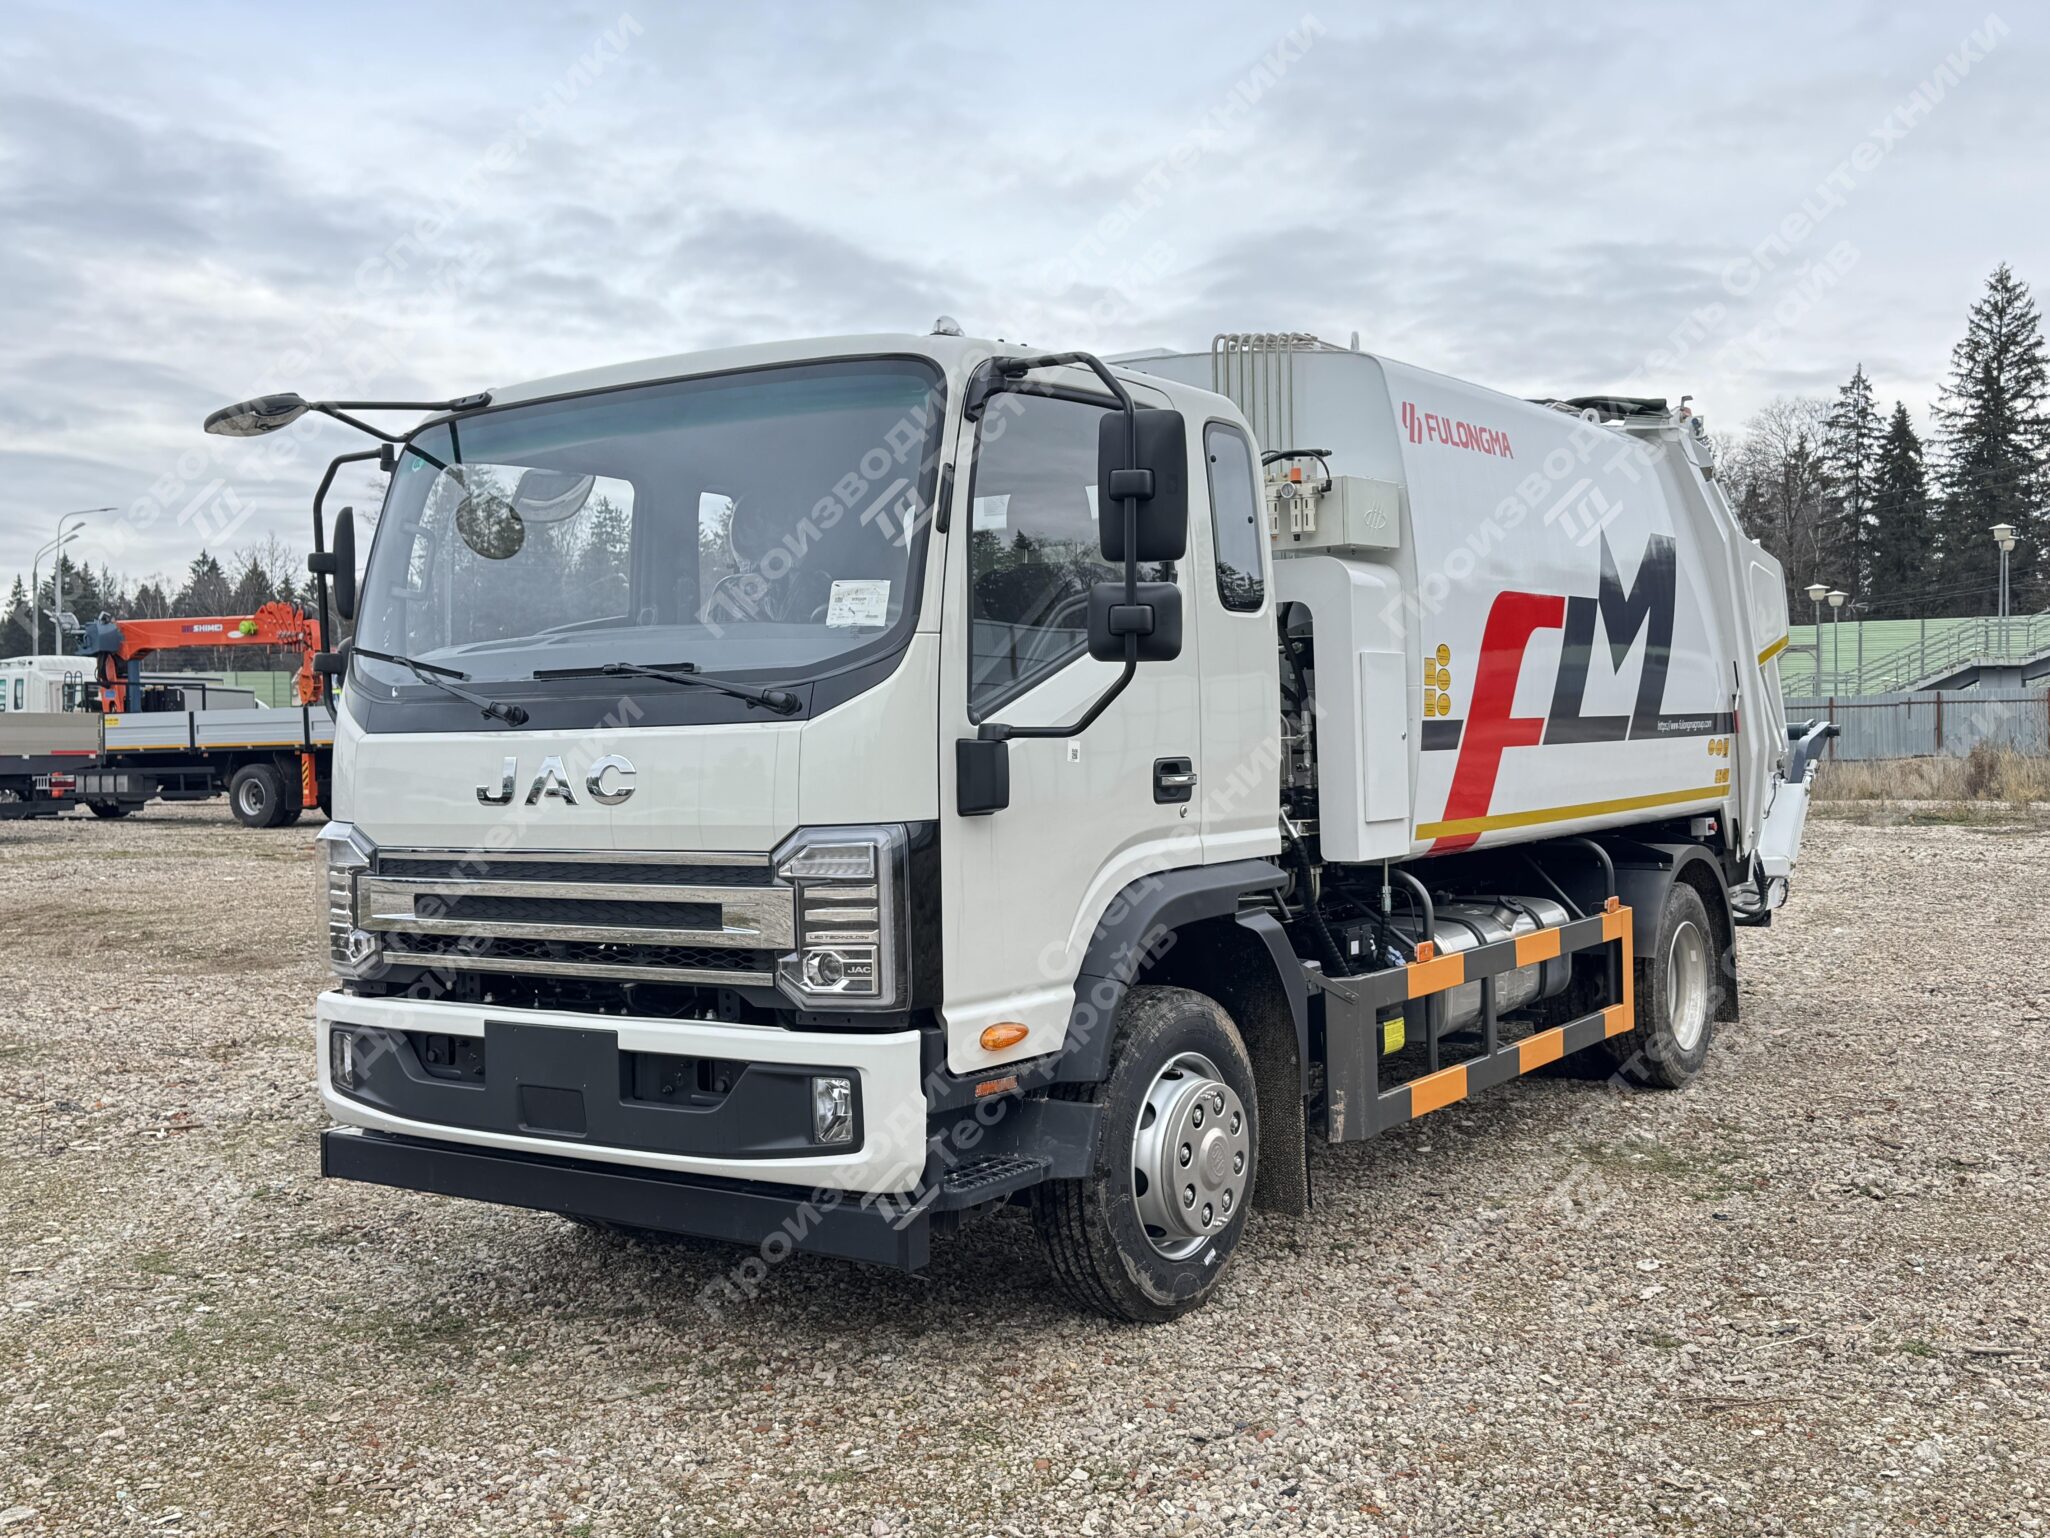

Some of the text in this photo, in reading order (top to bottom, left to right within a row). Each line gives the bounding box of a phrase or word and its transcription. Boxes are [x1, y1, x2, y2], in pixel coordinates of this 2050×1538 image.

[1425, 413, 1514, 459] FULONGMA
[476, 753, 637, 807] JAC
[847, 966, 872, 974] JAC
